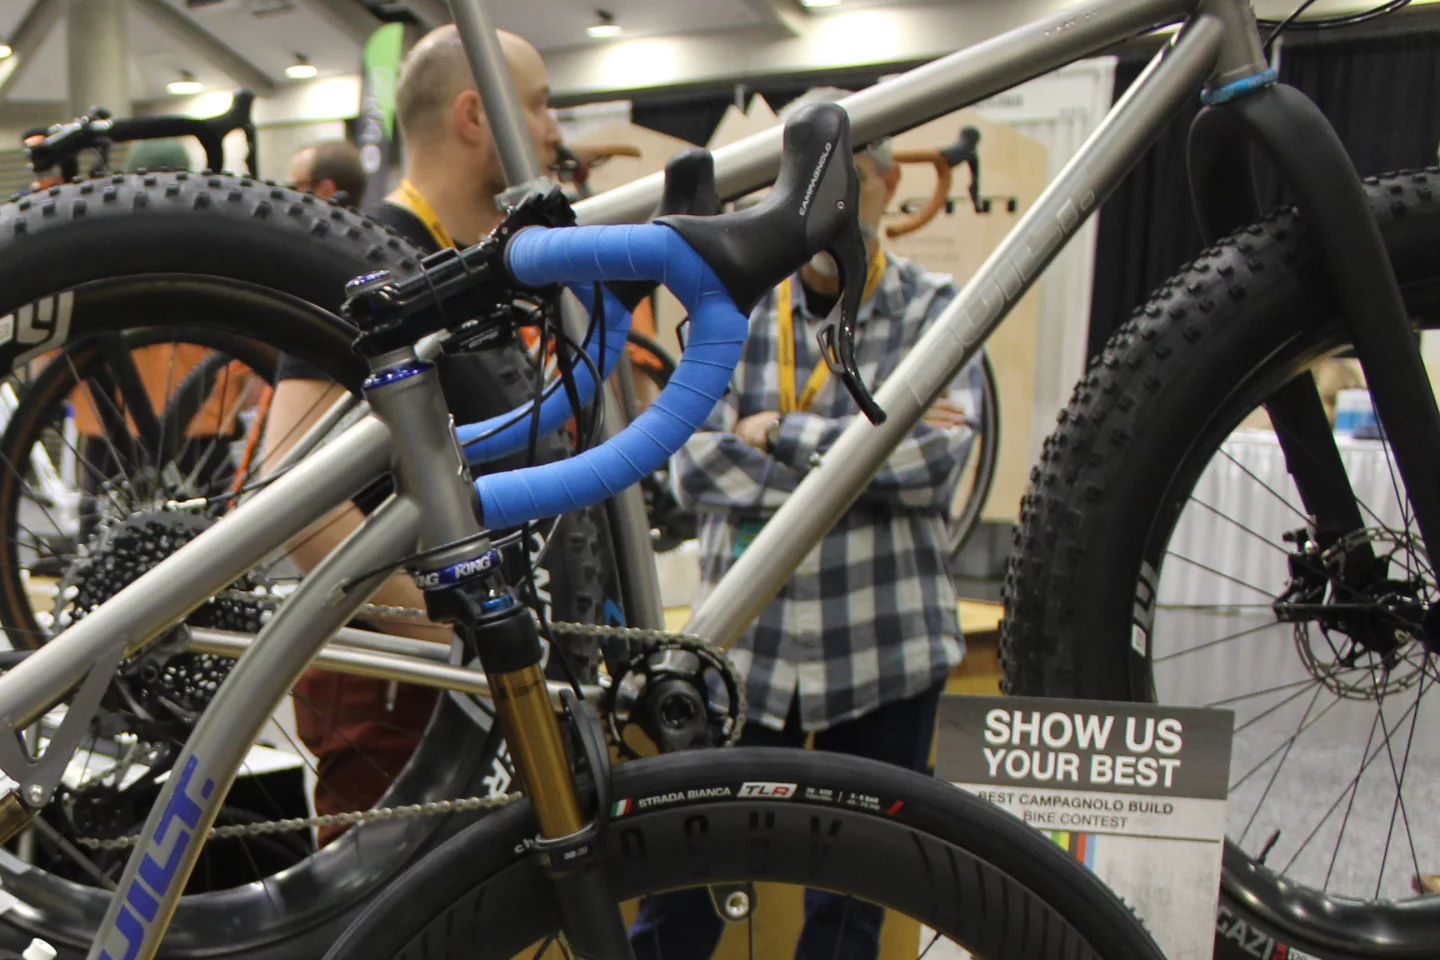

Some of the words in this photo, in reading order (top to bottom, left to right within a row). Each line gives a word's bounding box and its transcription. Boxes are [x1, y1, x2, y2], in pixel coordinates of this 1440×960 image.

[799, 142, 832, 216] CAMPAGNOLO
[455, 555, 492, 579] KING
[983, 708, 1115, 750] SHOW
[1125, 716, 1183, 755] US
[983, 747, 1080, 782] YOUR
[1090, 754, 1181, 788] BEST
[639, 791, 685, 808] STRADA
[687, 787, 731, 799] BIANCA
[746, 784, 791, 797] TLR
[1019, 793, 1125, 812] CAMPAGNOLO
[1128, 800, 1173, 816] BUILD
[1023, 811, 1056, 824] BIKE
[1060, 812, 1129, 829] CONTEST
